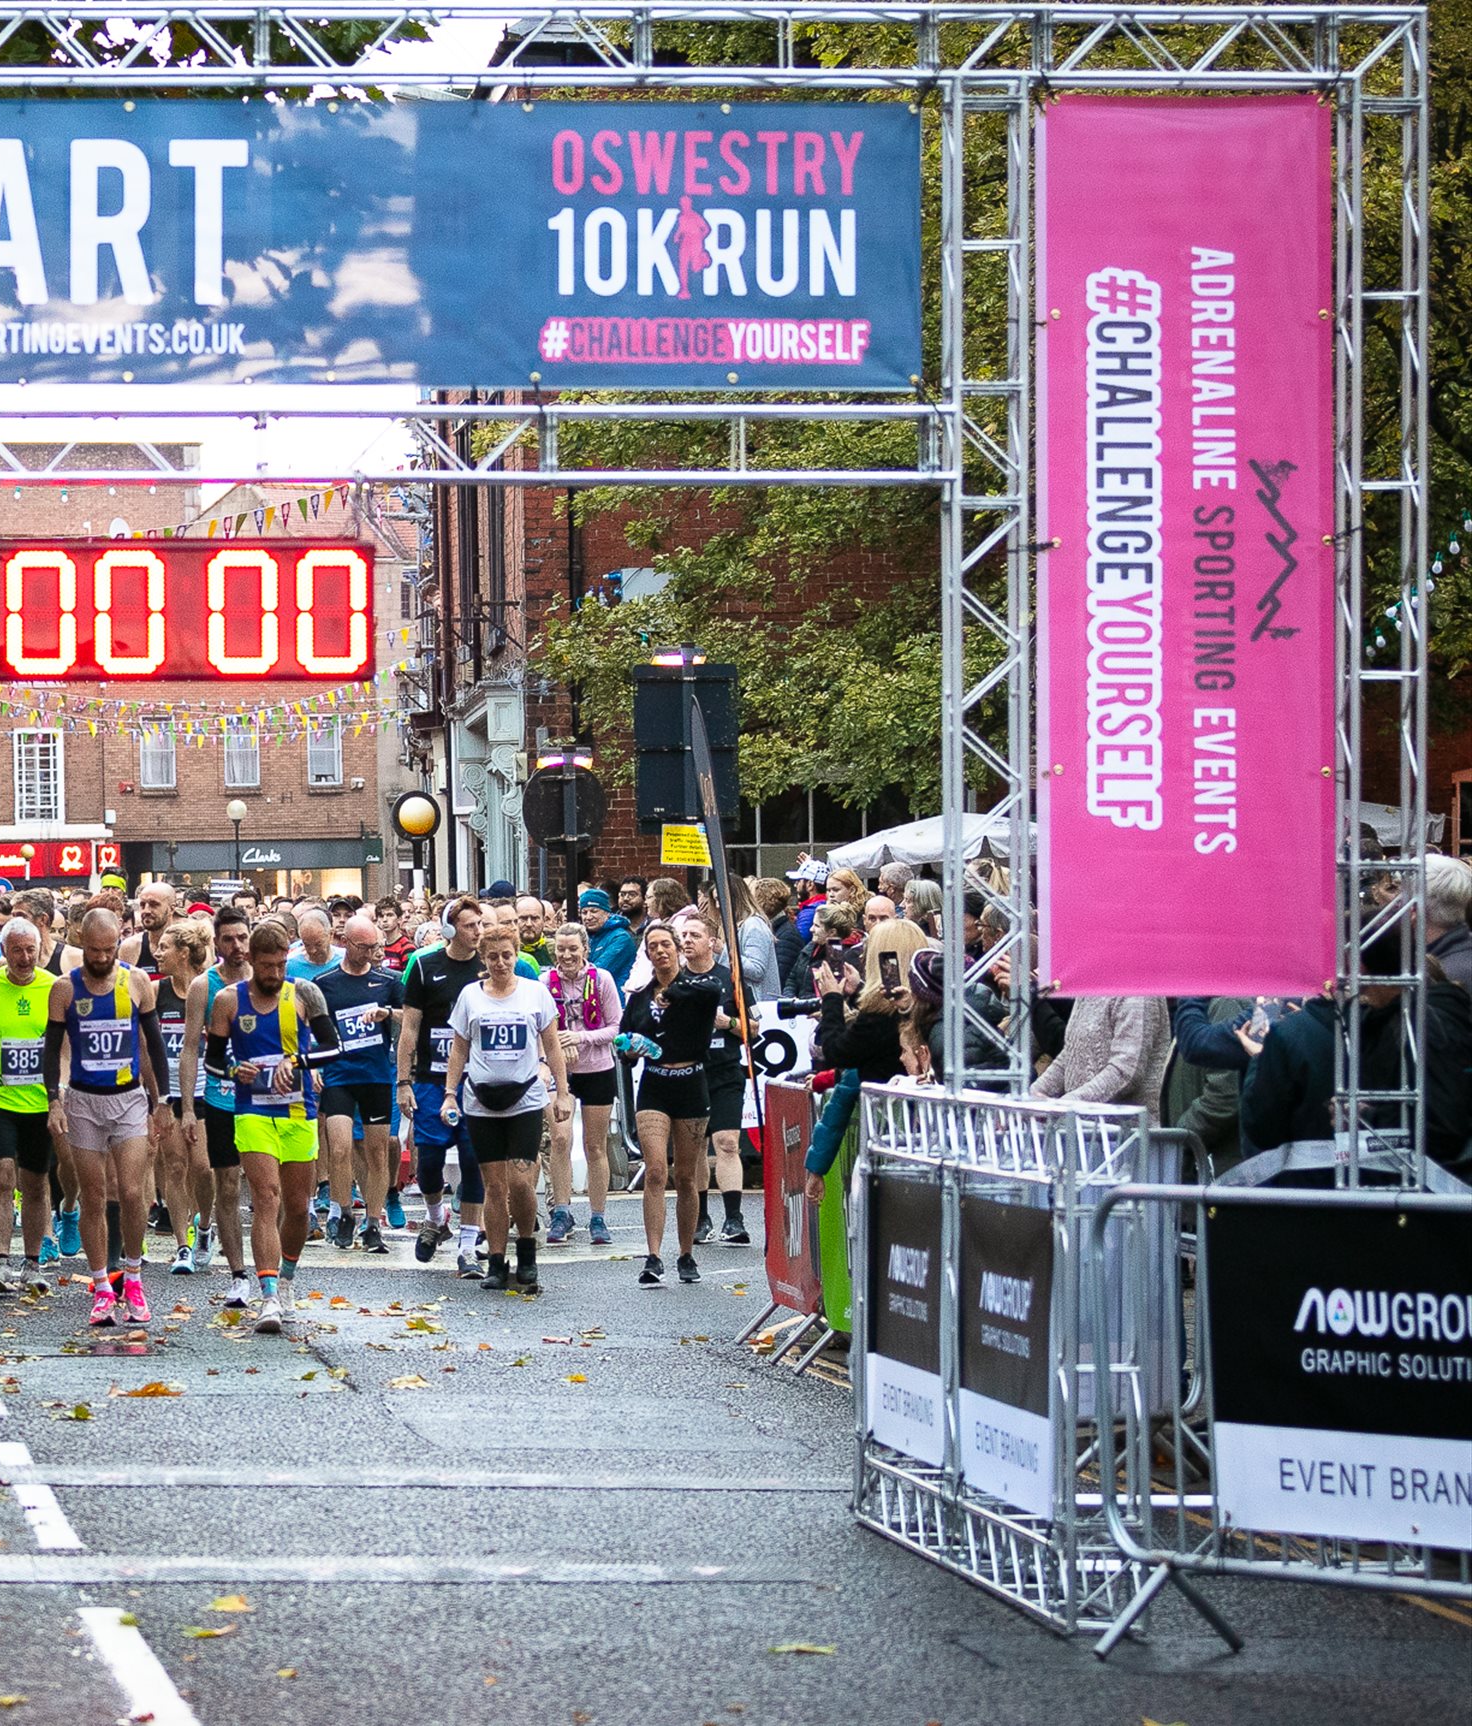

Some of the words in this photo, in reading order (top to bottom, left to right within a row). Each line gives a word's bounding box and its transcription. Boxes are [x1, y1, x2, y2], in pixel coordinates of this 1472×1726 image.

[552, 130, 864, 195] OSWESTRY
[548, 207, 681, 296] 10K
[703, 208, 856, 296] RUN
[1190, 246, 1236, 491] ADRENALINE
[1193, 505, 1236, 692] SPORTING
[1193, 706, 1237, 856] EVENTS
[242, 848, 281, 863] Clarks
[89, 1032, 123, 1053] 307
[487, 1025, 517, 1045] 791
[7, 1049, 39, 1069] 385
[646, 1065, 668, 1076] NIKE
[669, 1067, 693, 1077] PRO
[1301, 1347, 1392, 1378] GRAPHIC
[1278, 1457, 1376, 1500] EVENT
